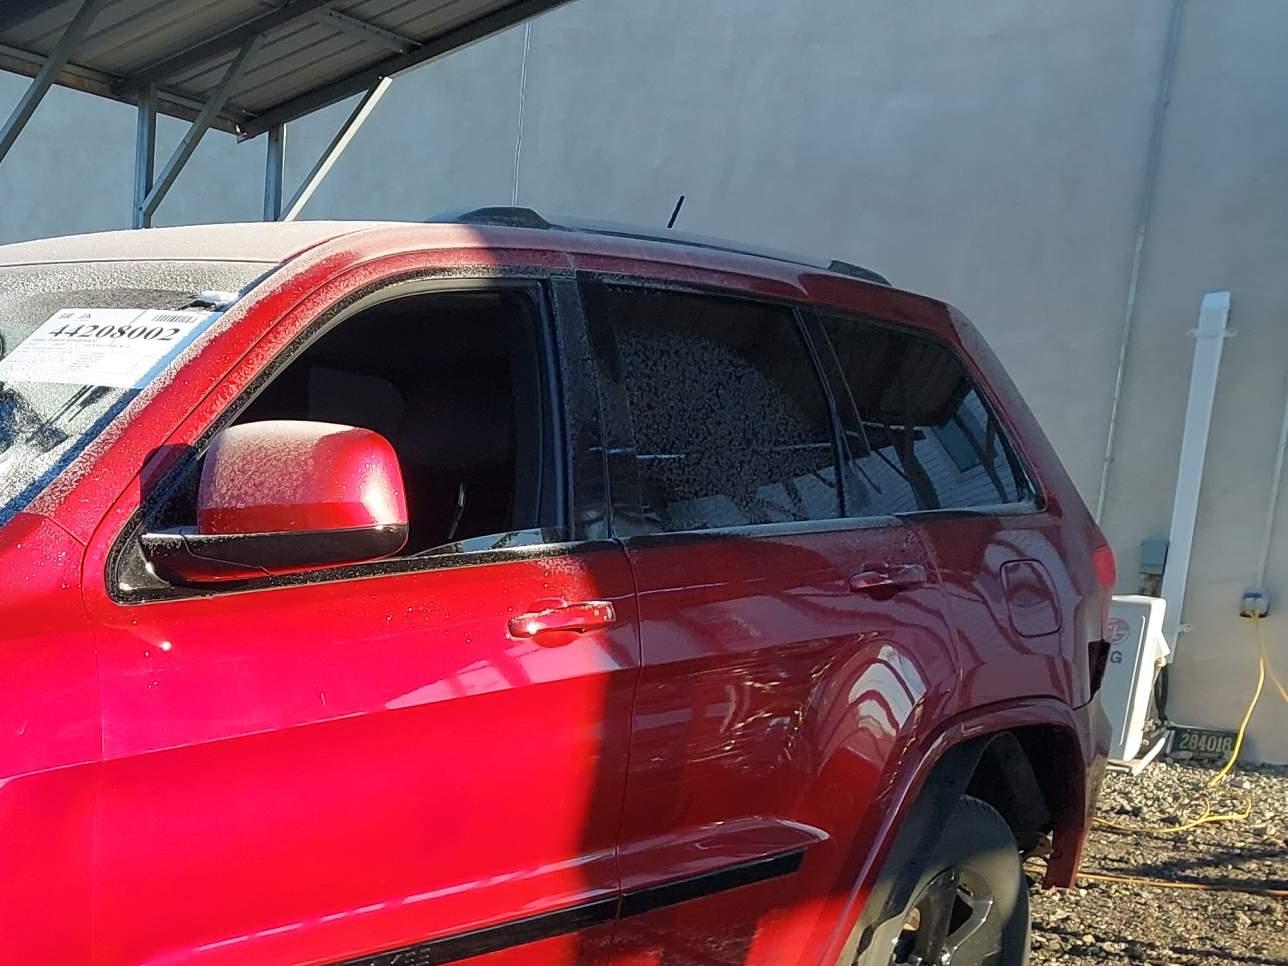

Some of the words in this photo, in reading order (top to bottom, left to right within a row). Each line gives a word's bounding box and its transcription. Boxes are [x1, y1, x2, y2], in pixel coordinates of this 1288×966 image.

[48, 323, 182, 341] 44208002
[1110, 650, 1123, 664] G
[1179, 733, 1232, 752] 284018
